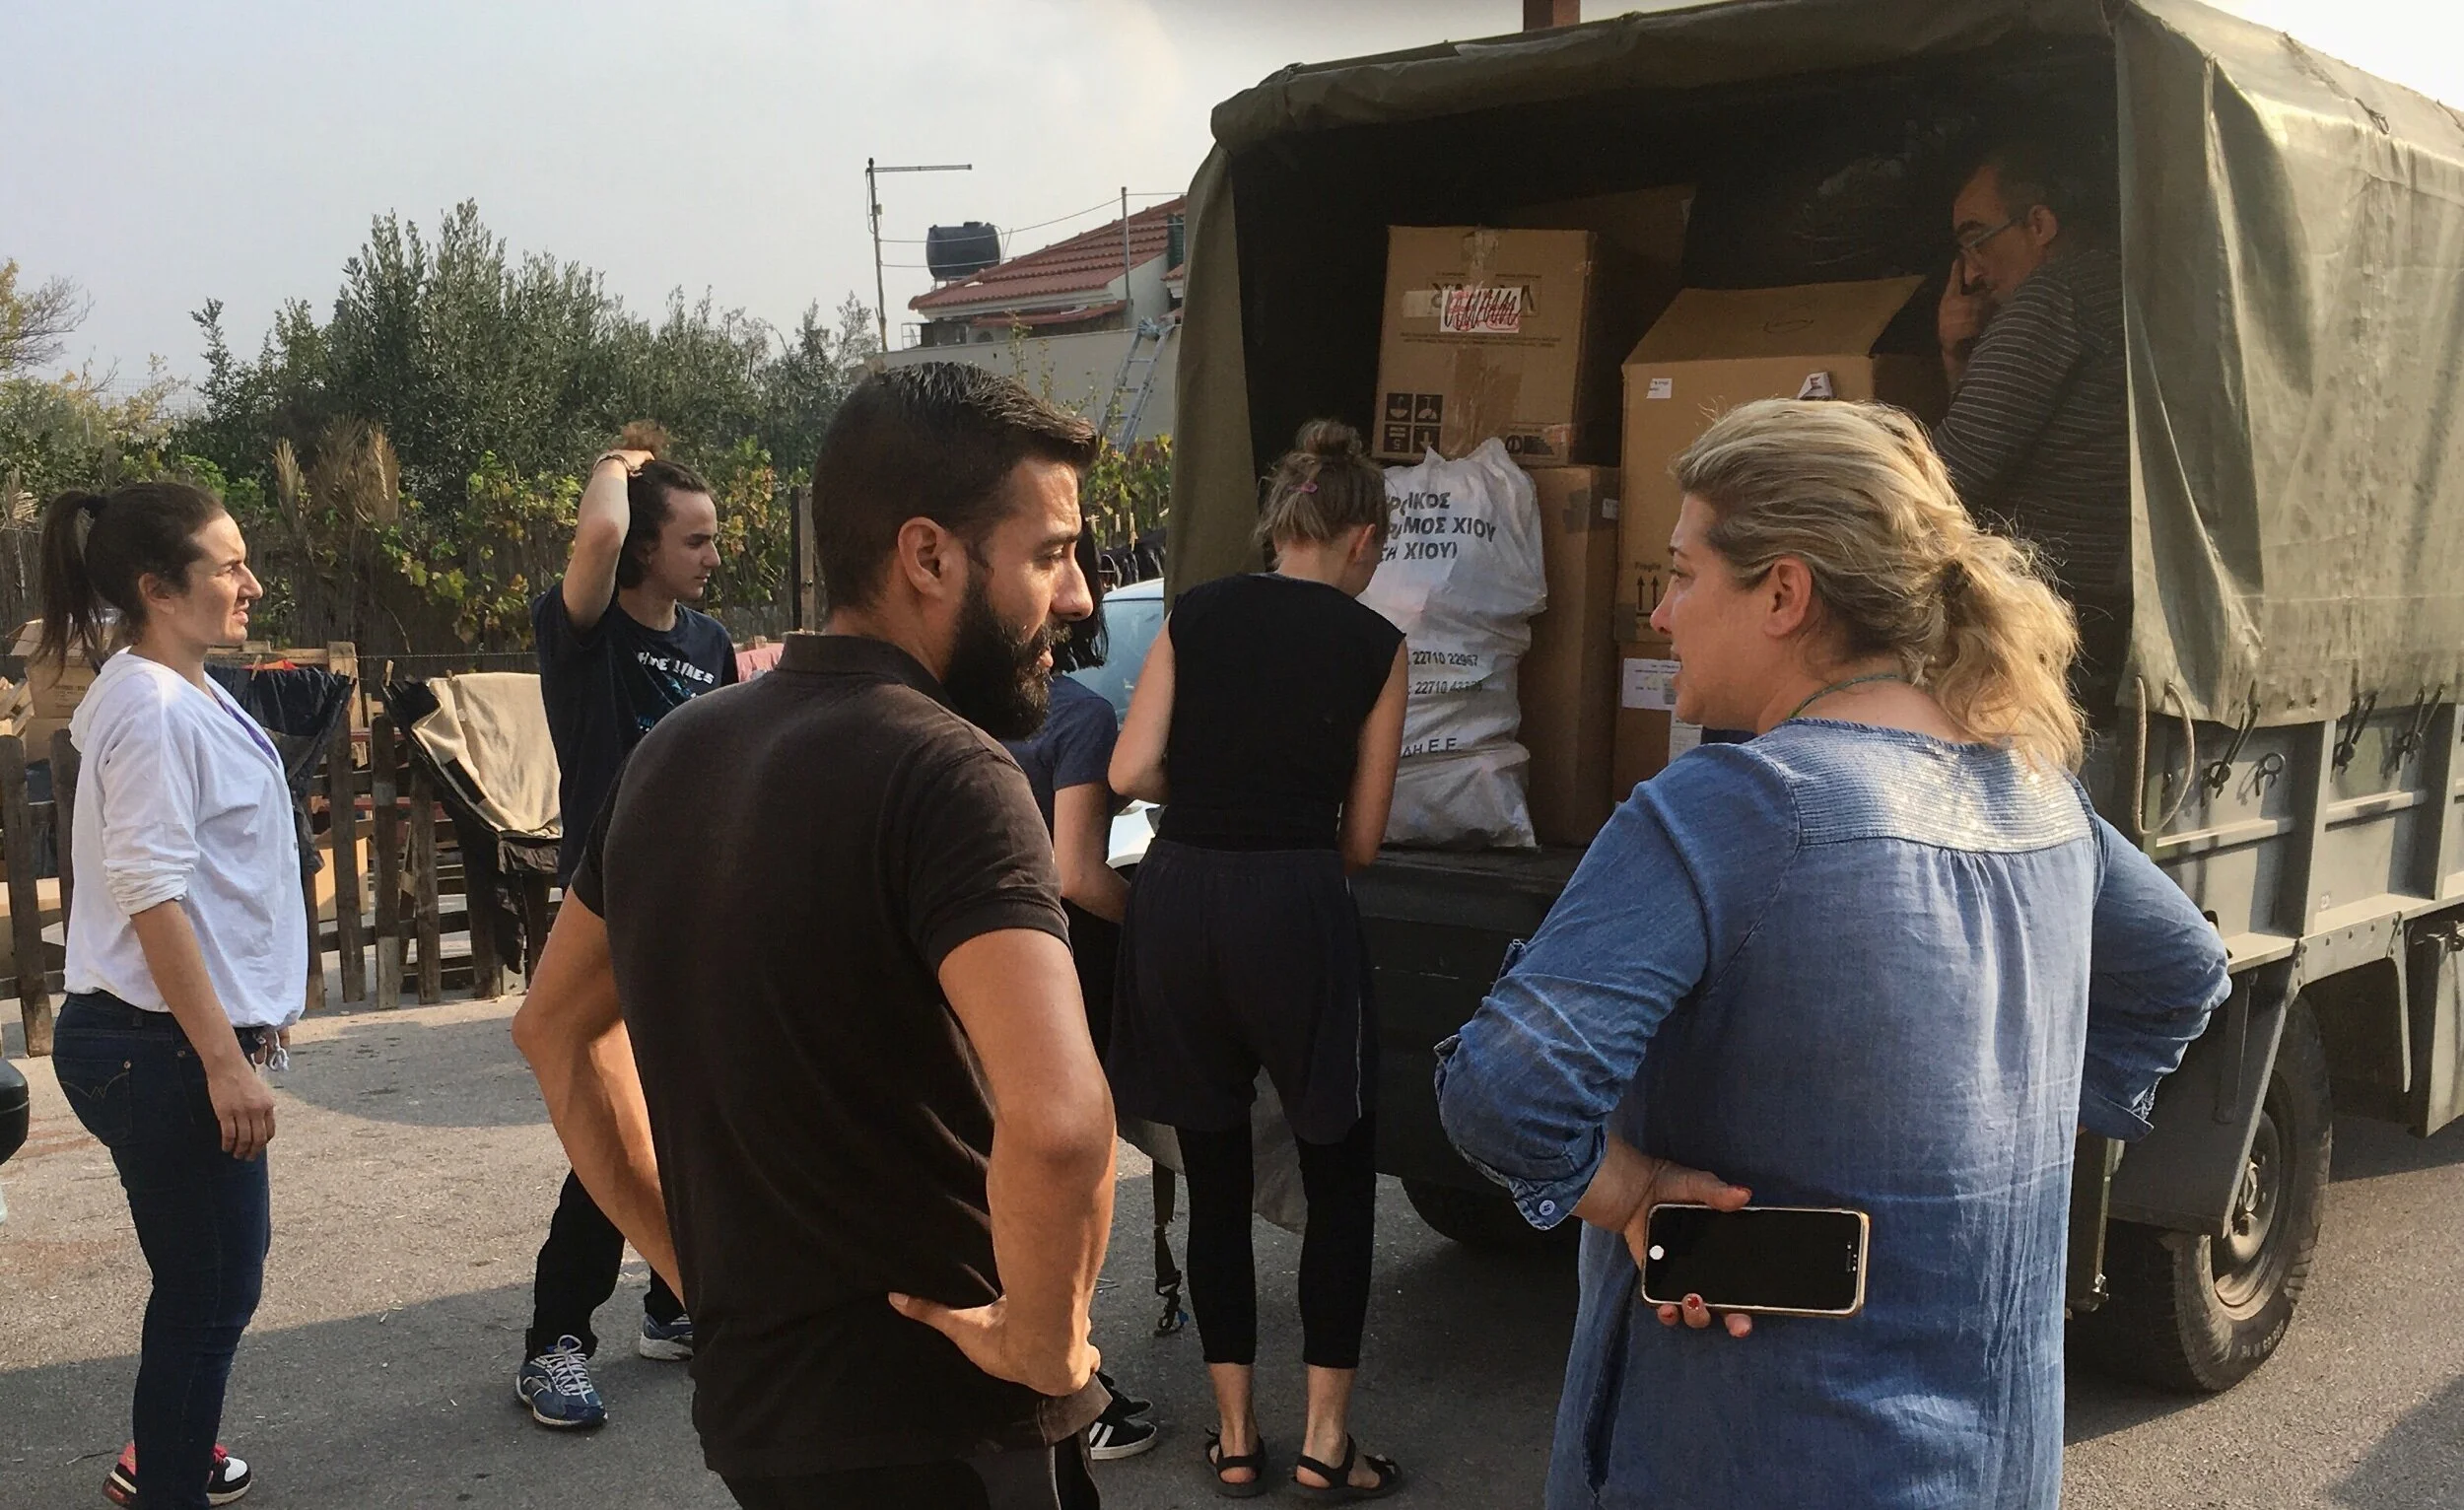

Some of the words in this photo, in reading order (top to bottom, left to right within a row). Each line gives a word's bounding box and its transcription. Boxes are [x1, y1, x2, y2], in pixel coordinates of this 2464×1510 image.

[1452, 517, 1496, 542] ΧΙΟΥ
[1403, 541, 1458, 560] ΧΙΟΥ)
[1412, 651, 1446, 665] 22710
[1414, 680, 1449, 695] 22710
